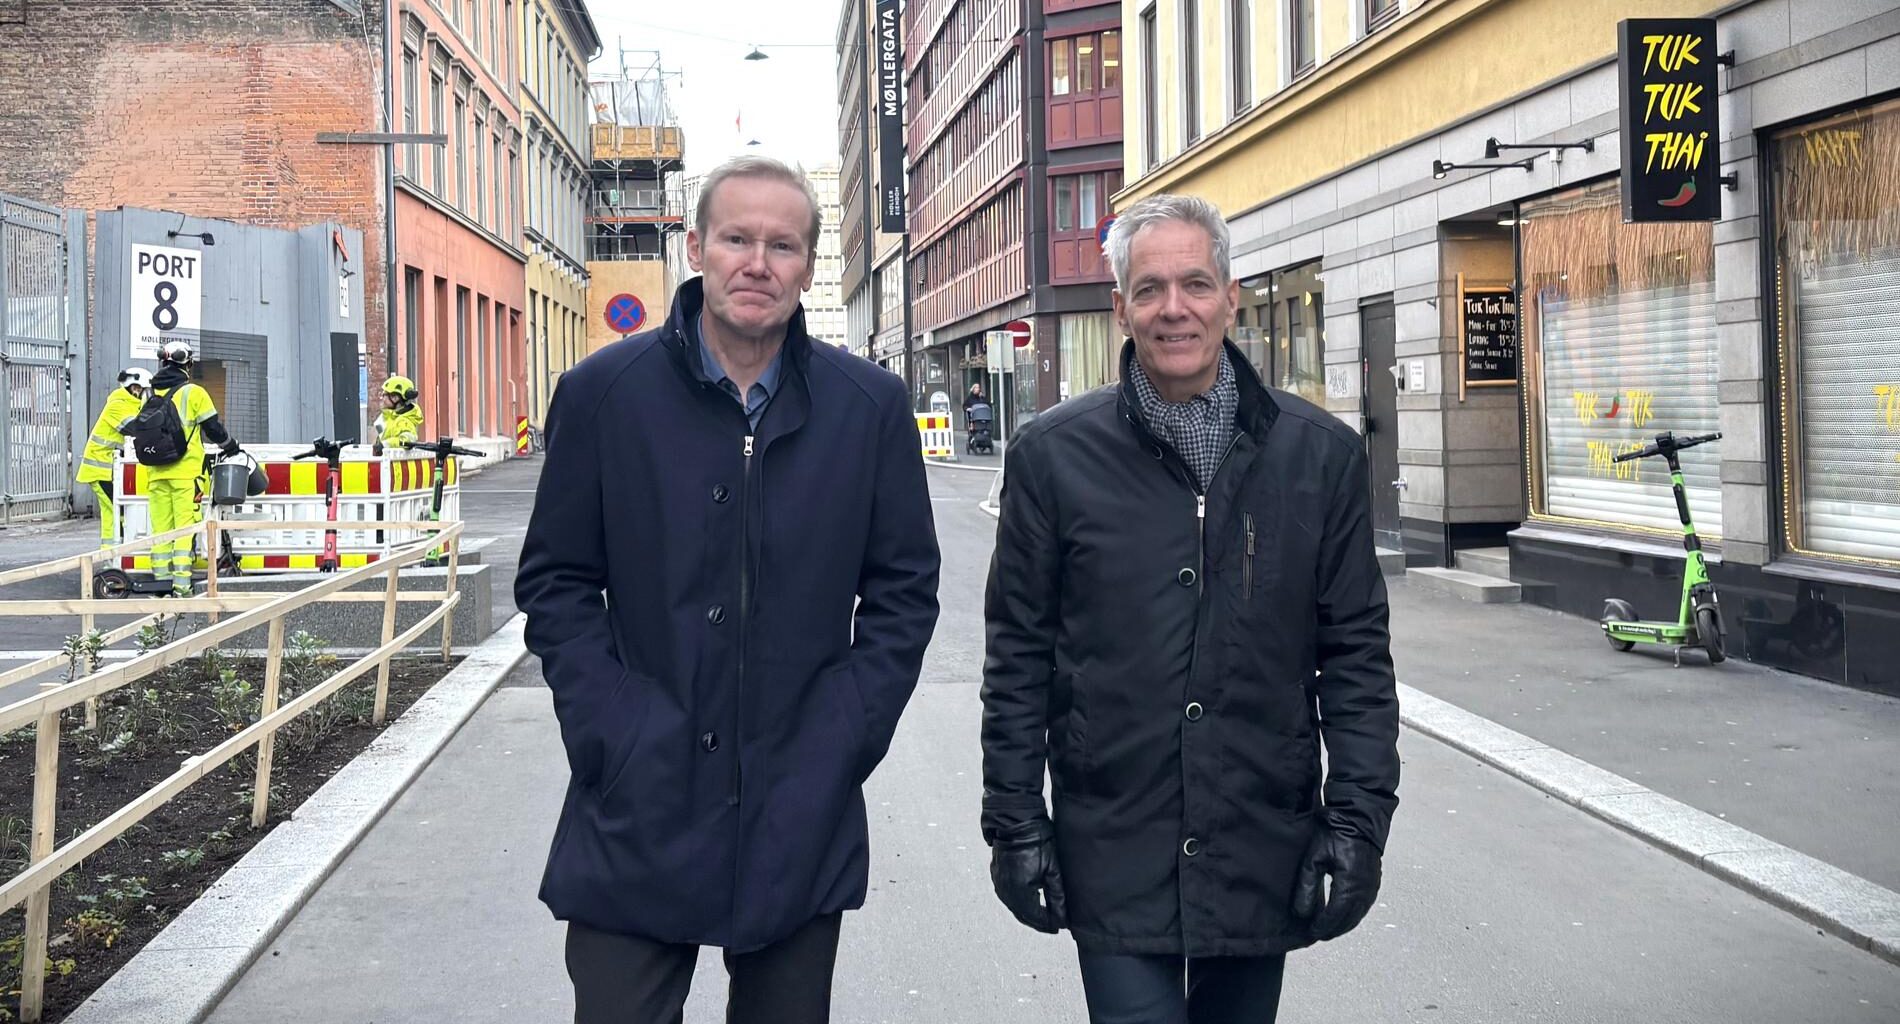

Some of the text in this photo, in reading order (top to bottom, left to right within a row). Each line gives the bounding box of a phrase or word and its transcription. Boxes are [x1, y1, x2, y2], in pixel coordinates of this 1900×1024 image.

[883, 9, 897, 116] MØLLERGATA
[1643, 34, 1702, 76] TUK
[1644, 82, 1703, 125] TUK
[138, 251, 197, 279] PORT
[152, 281, 179, 331] 8
[1464, 296, 1515, 315] TUK TUK THA
[1573, 391, 1655, 428] TUK TUK
[1872, 384, 1900, 433] TU
